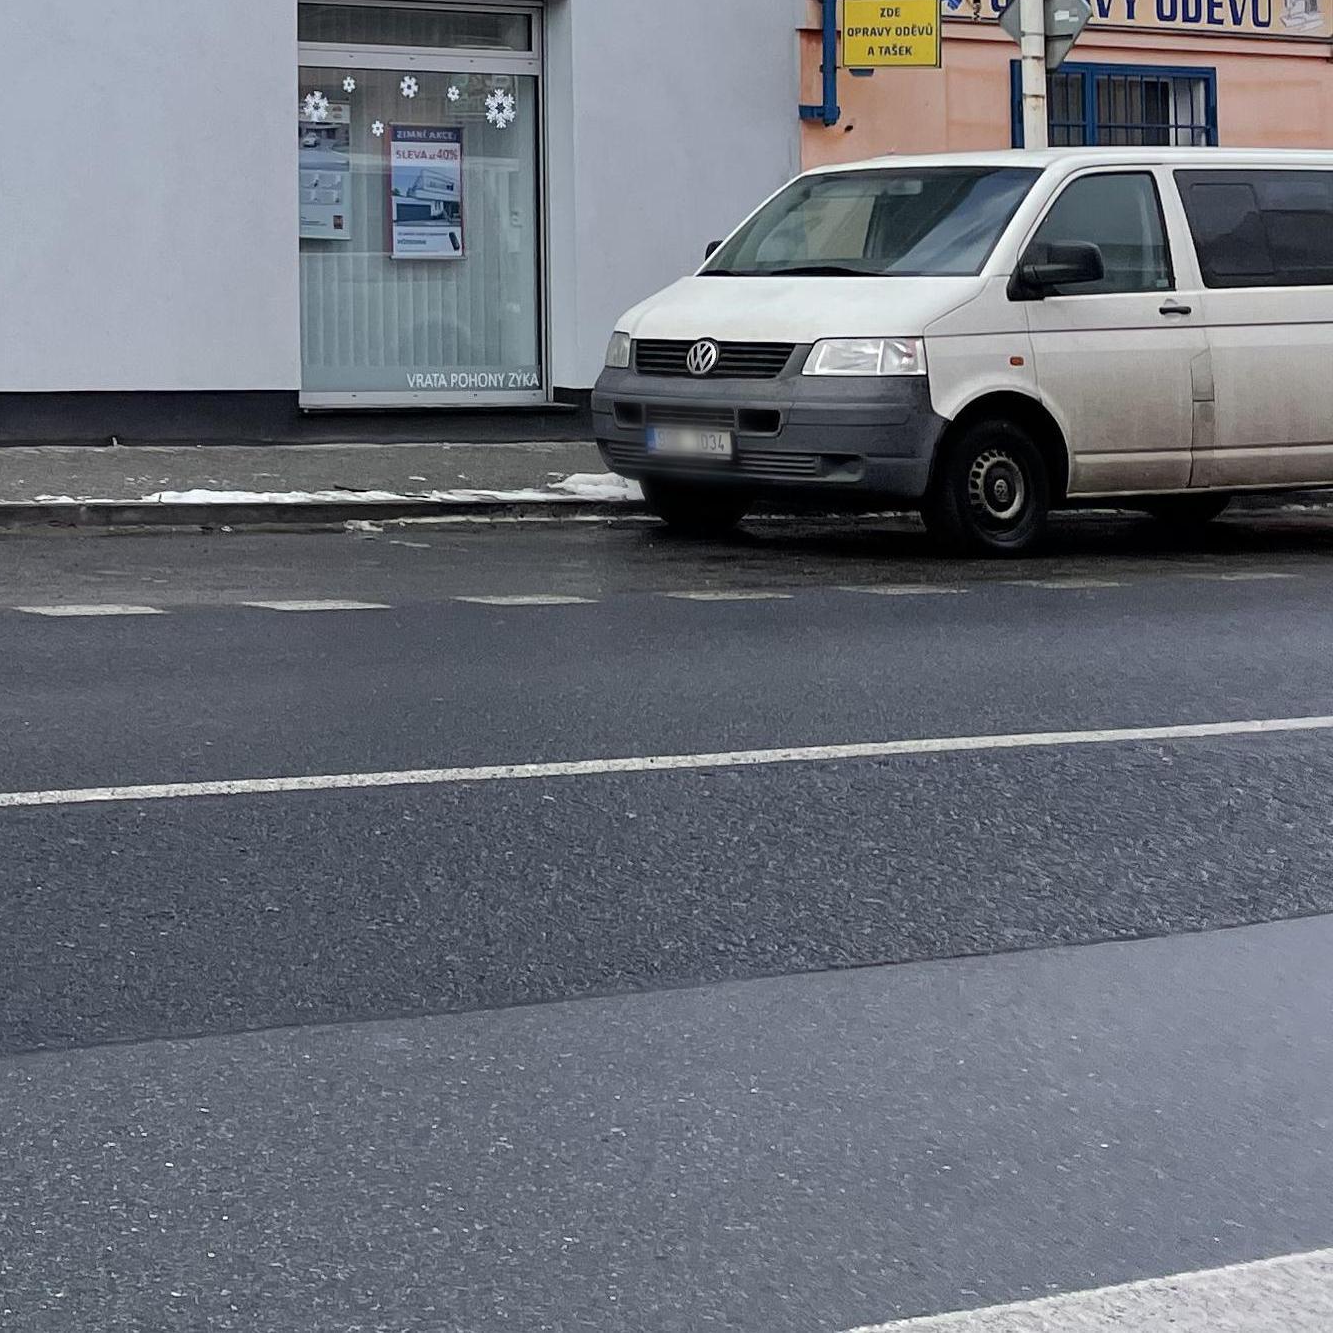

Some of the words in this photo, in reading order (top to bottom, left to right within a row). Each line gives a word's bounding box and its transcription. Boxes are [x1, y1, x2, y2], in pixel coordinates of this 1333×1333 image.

[880, 7, 901, 18] ZDE
[847, 27, 891, 37] OPRAVY
[895, 22, 933, 36] ODĚVŮ
[867, 46, 875, 56] A
[878, 43, 912, 56] TAŠEK
[406, 373, 447, 387] VRATA
[450, 373, 505, 387] POHONY
[508, 368, 539, 387] ZÝKA
